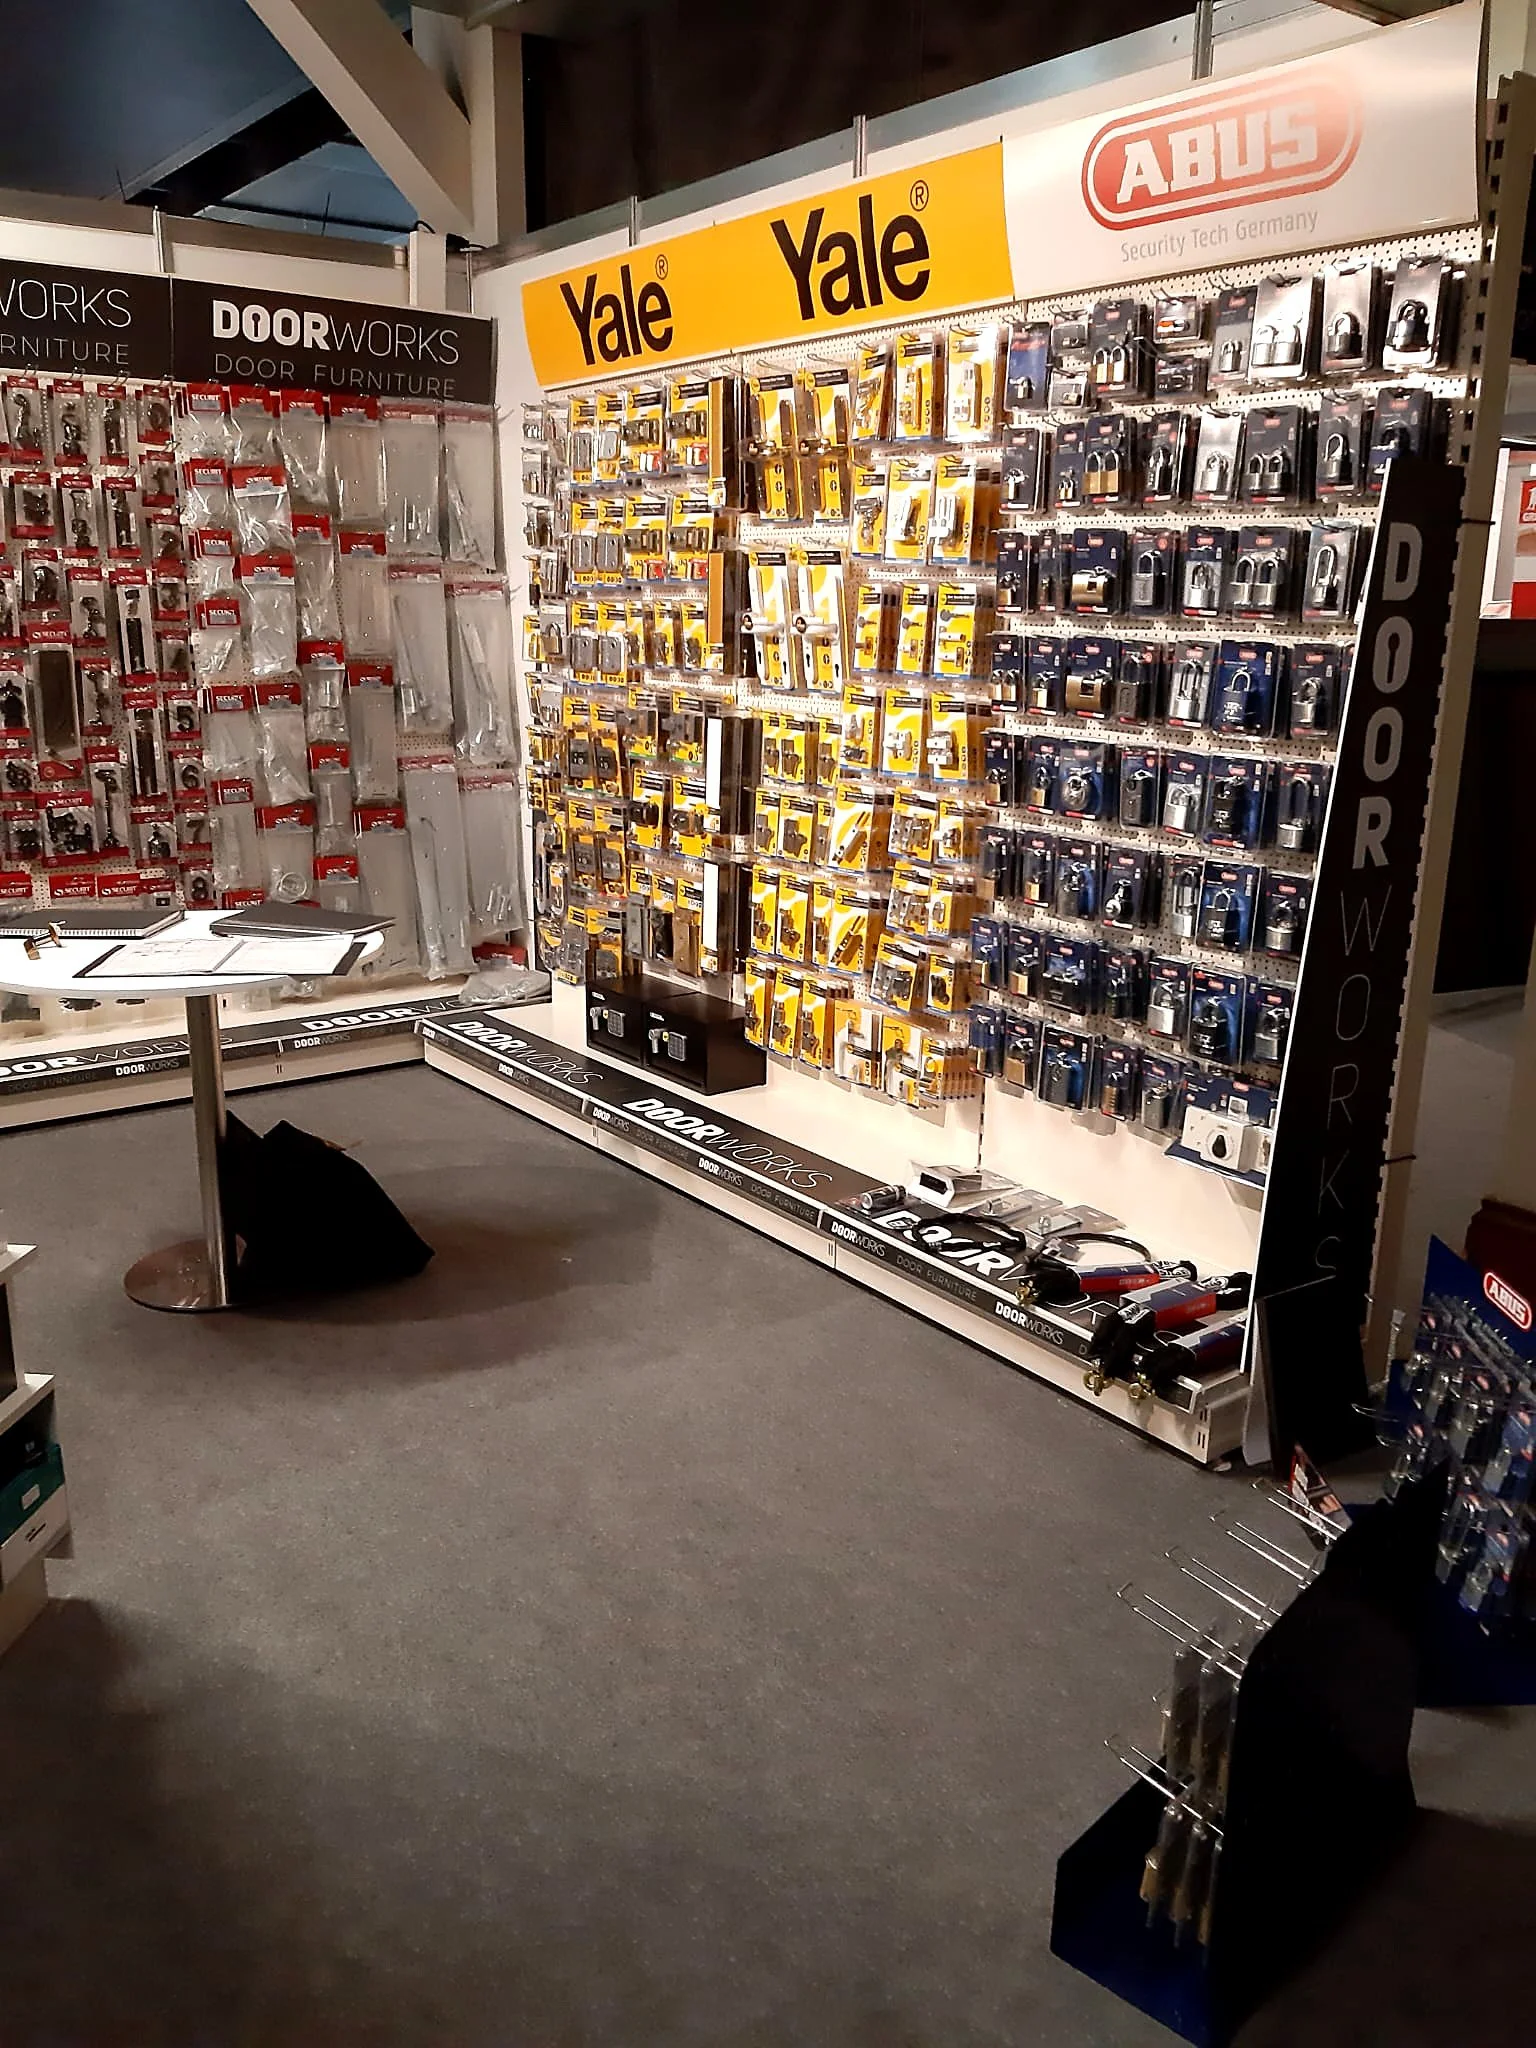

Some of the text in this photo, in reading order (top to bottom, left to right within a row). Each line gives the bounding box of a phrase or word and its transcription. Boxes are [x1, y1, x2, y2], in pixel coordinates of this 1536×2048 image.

[1117, 100, 1319, 204] ABUS
[1121, 210, 1319, 263] Security Tech Germany
[213, 299, 459, 366] DOORWORKS
[215, 353, 457, 398] DOOR FURNITURE
[115, 1058, 180, 1077] DOORWORKS
[447, 1021, 604, 1085] DOORWORKS
[622, 1098, 833, 1188] DOORWORKS
[698, 1157, 816, 1222] DOORWORKS DOOR FURNITURE
[831, 1220, 978, 1301] DOORWORKS DOOR FURNITURE
[995, 1300, 1064, 1346] DOORWORKS
[1488, 1279, 1527, 1324] ABUS
